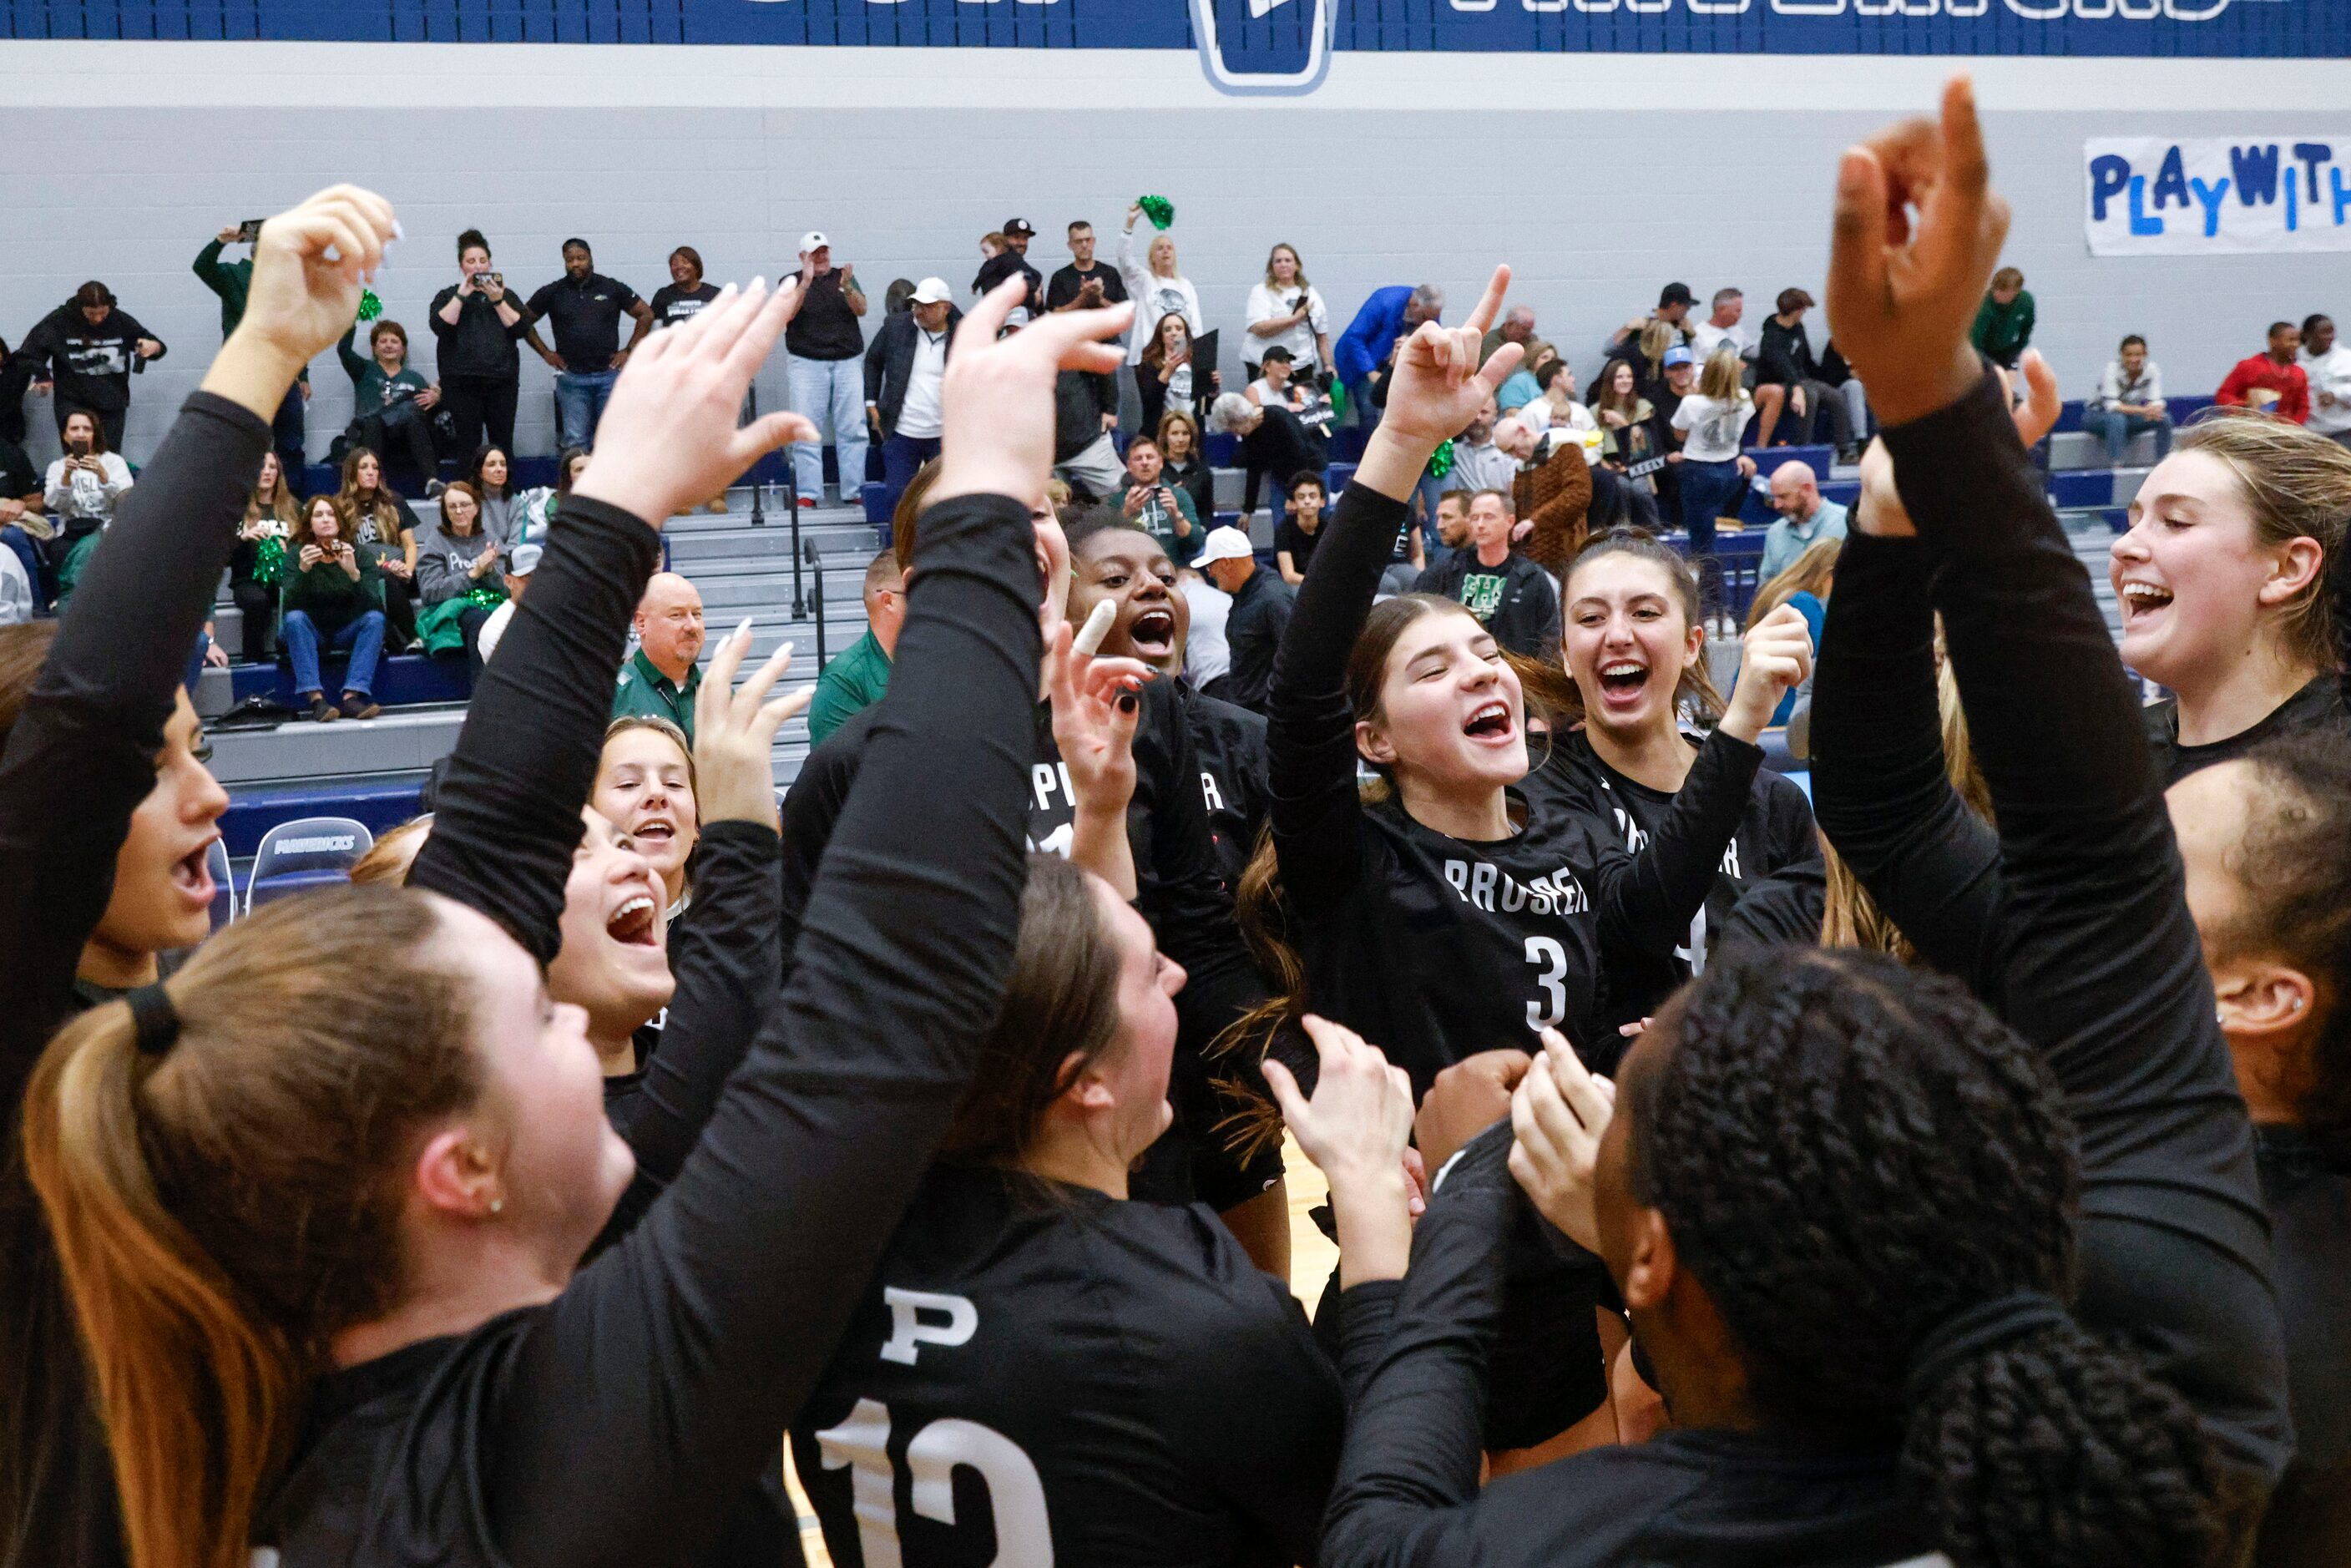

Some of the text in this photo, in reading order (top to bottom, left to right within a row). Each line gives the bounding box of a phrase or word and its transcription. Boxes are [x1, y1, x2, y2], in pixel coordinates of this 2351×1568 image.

[2090, 145, 2230, 237] PLAY
[1524, 936, 1568, 1033] 3
[880, 1286, 978, 1366] P
